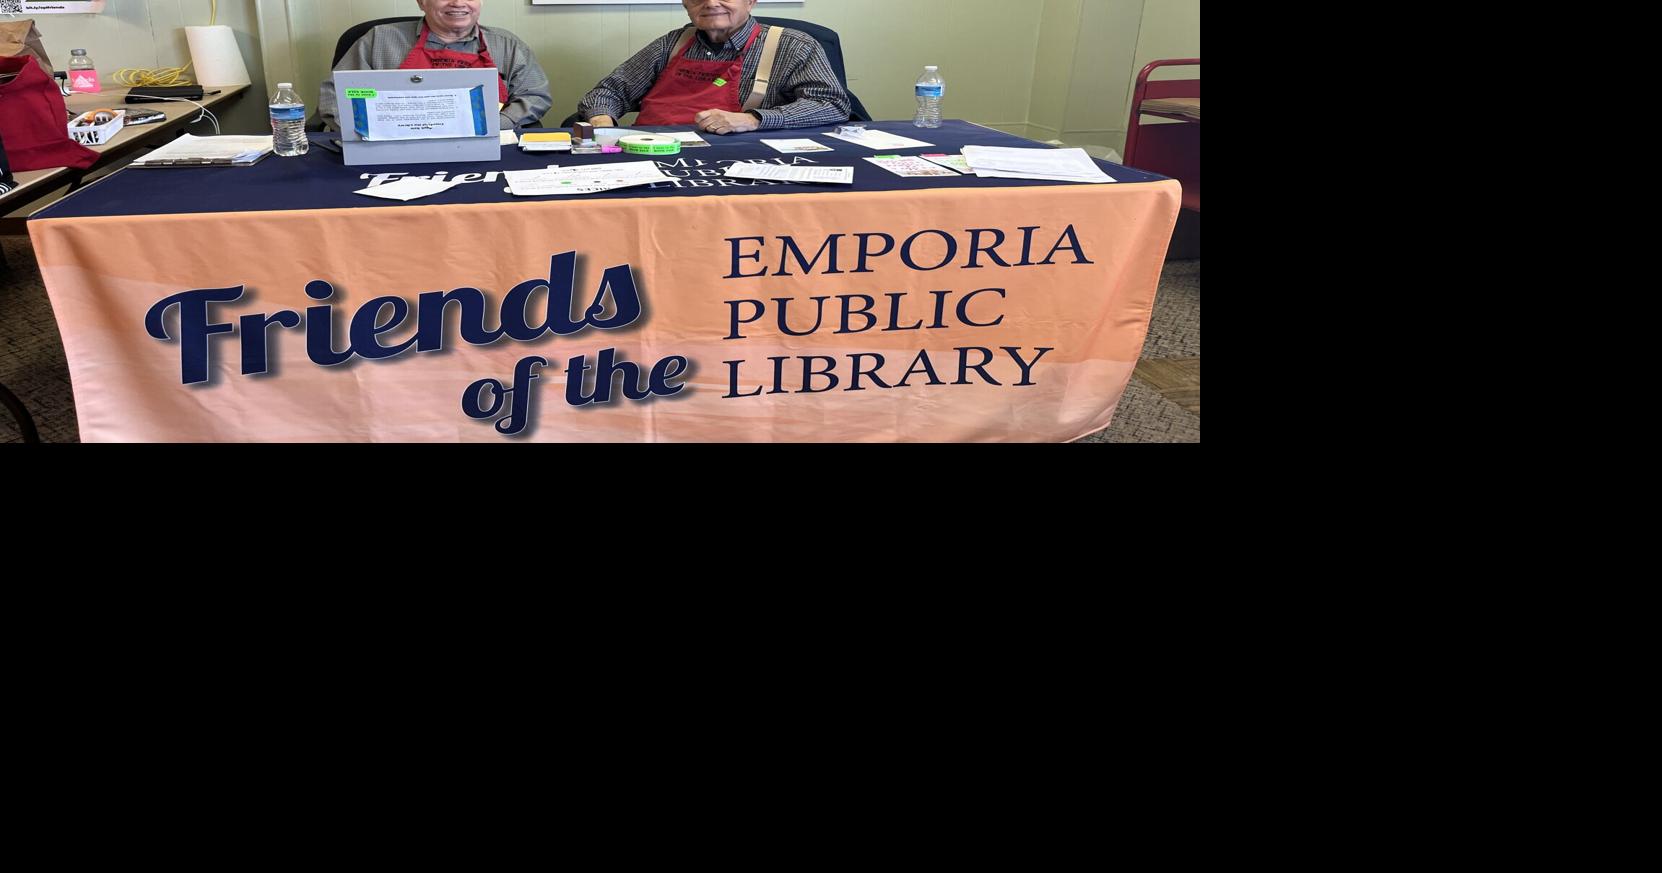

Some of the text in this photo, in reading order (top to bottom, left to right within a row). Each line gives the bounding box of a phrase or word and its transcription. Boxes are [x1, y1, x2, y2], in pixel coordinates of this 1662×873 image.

[722, 223, 1095, 279] EMPORIA
[144, 250, 643, 385] Friends
[722, 287, 1006, 340] PUBLIC
[461, 346, 689, 436] of the
[721, 346, 1054, 399] LIBRARY
